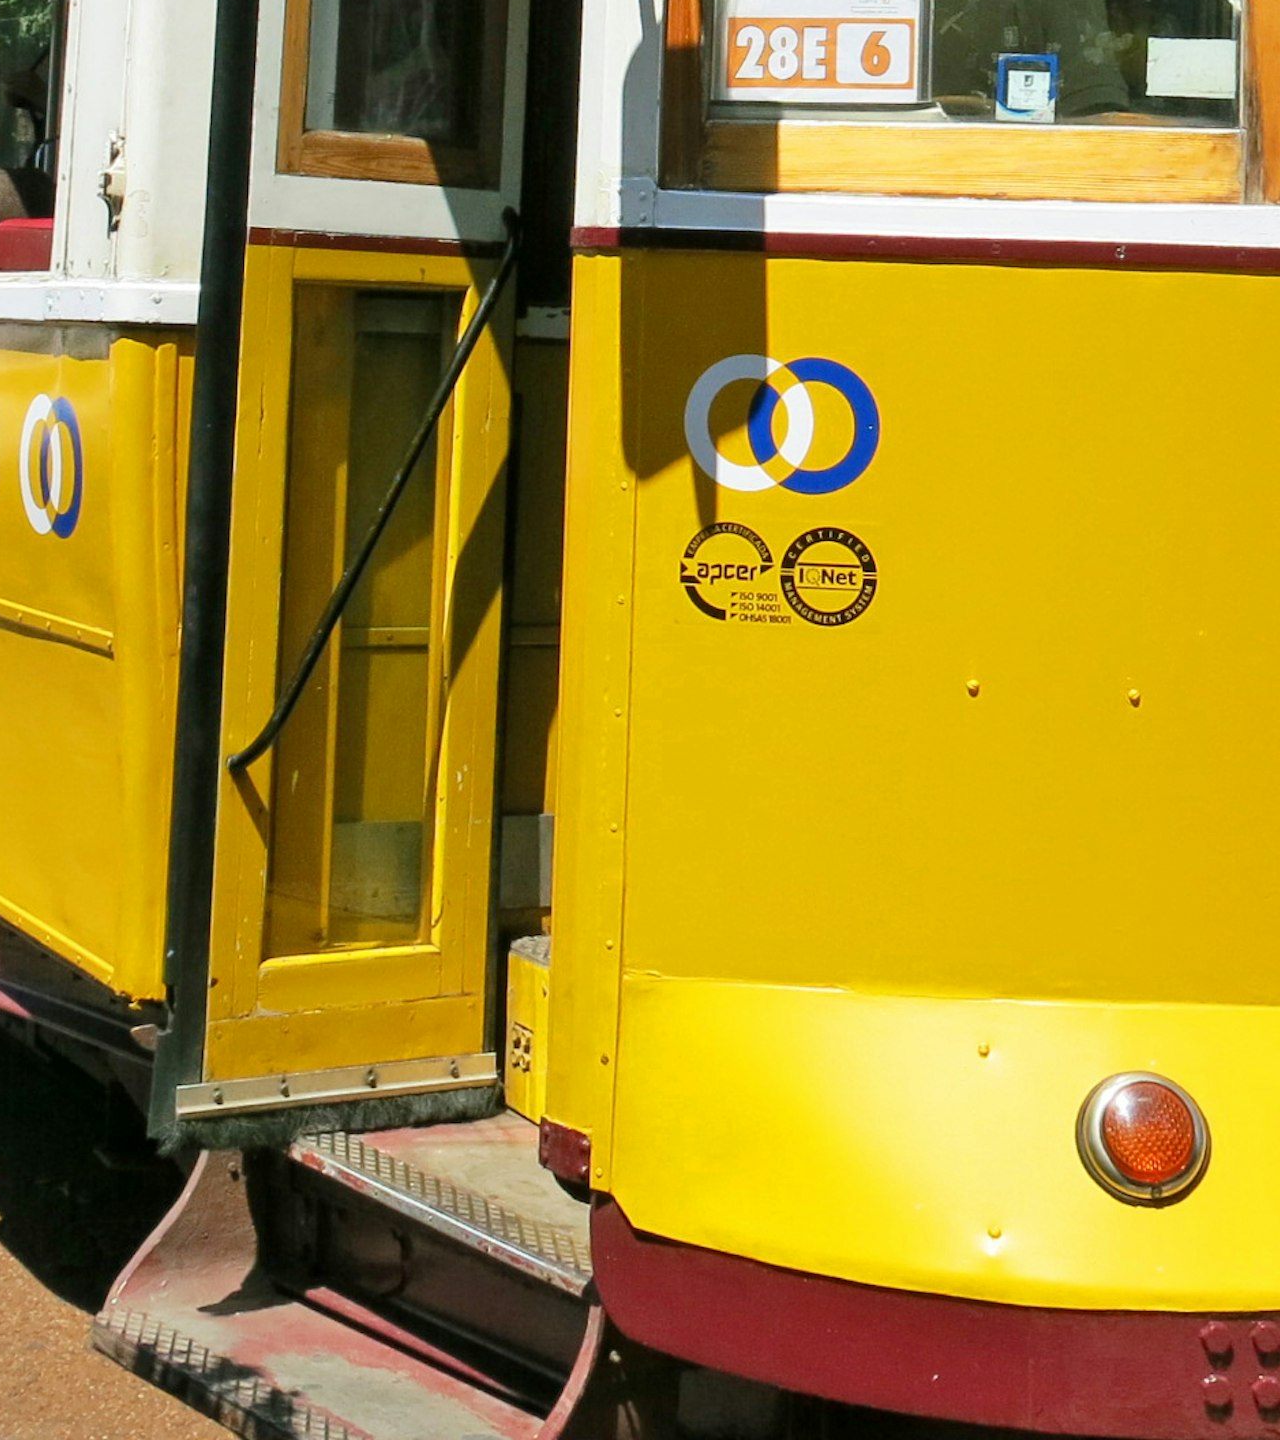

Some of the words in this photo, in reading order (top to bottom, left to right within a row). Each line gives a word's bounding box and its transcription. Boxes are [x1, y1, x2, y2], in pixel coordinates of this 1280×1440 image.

[735, 25, 829, 80] 28E
[860, 31, 892, 77] 6
[787, 530, 870, 562] CERTIFIED
[697, 563, 758, 585] apcer
[799, 567, 857, 587] IQNet
[784, 581, 842, 624] MANAGEMENT
[843, 585, 873, 620] SYSTEM
